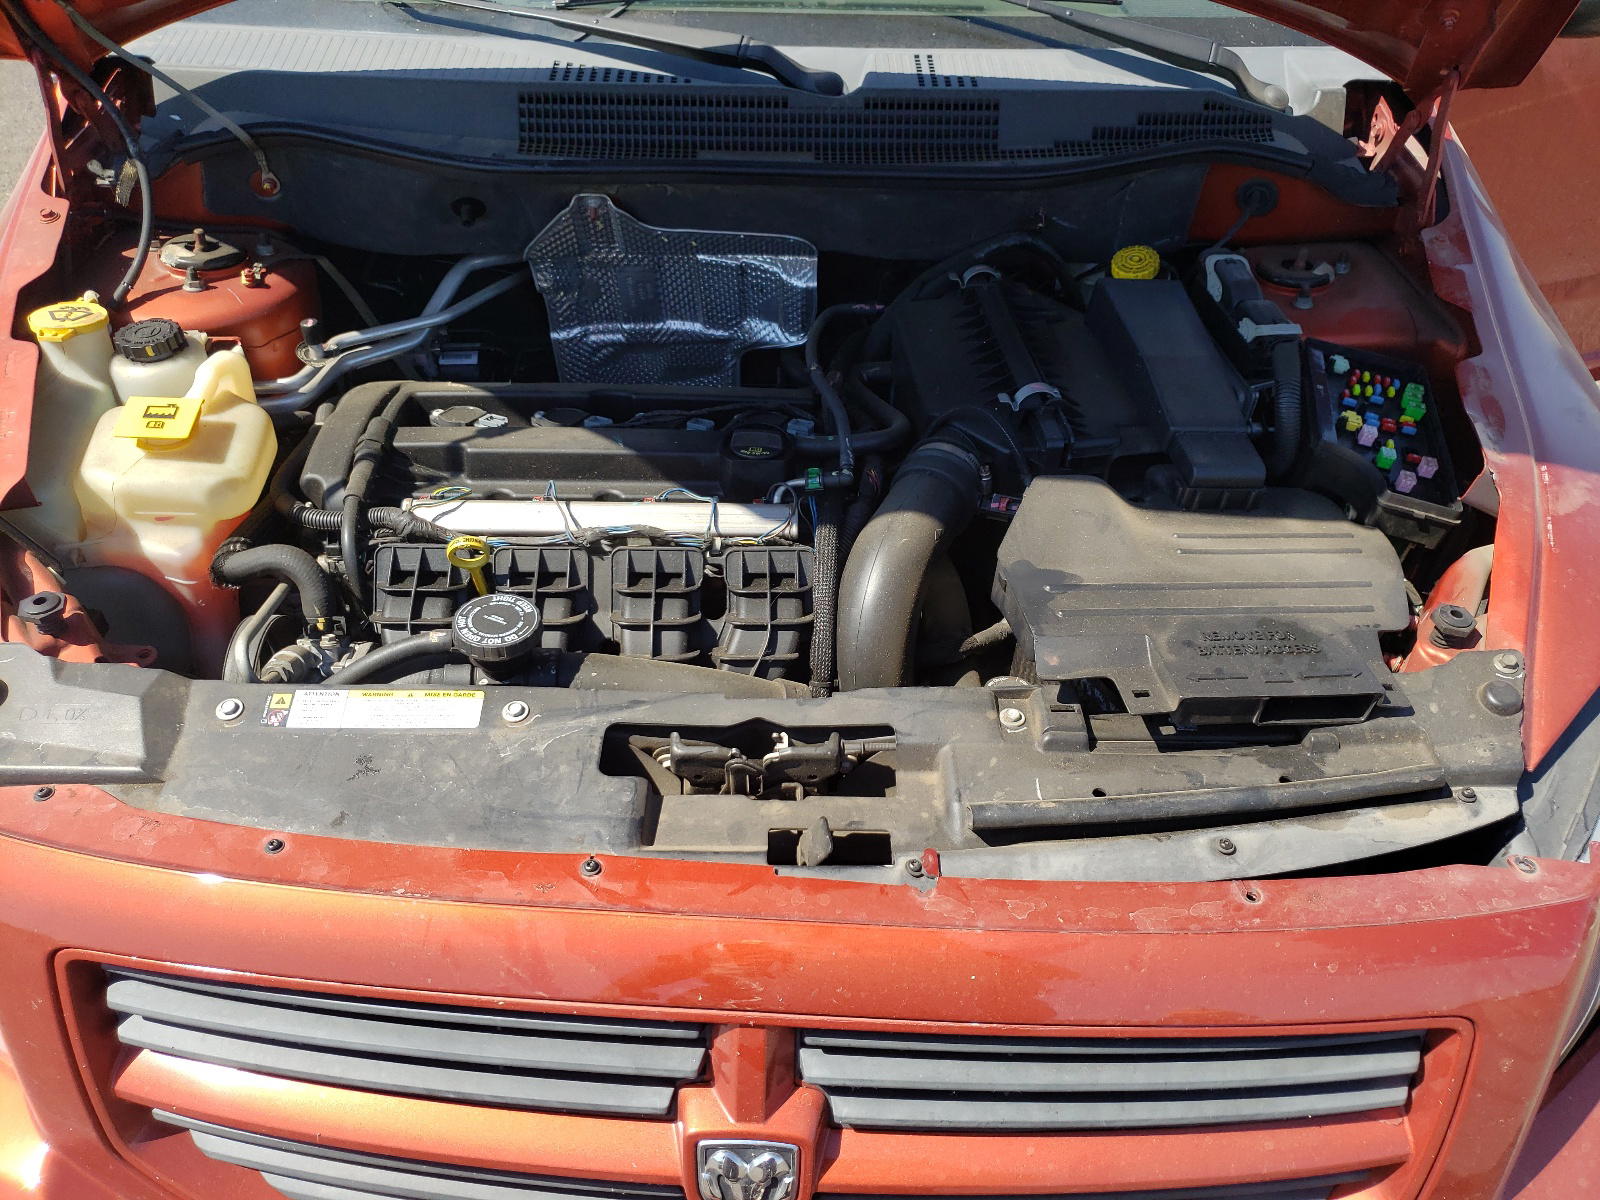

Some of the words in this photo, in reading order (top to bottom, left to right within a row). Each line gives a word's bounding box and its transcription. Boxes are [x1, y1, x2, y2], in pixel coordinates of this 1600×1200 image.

[516, 600, 533, 613] KEEP
[457, 615, 467, 628] HOT
[460, 628, 482, 642] OPEN
[504, 633, 519, 641] DO
[1201, 630, 1264, 642] REMOVE
[1266, 630, 1297, 642] FOR
[1198, 644, 1260, 656] BATTERY
[1264, 643, 1322, 655] ACCESS
